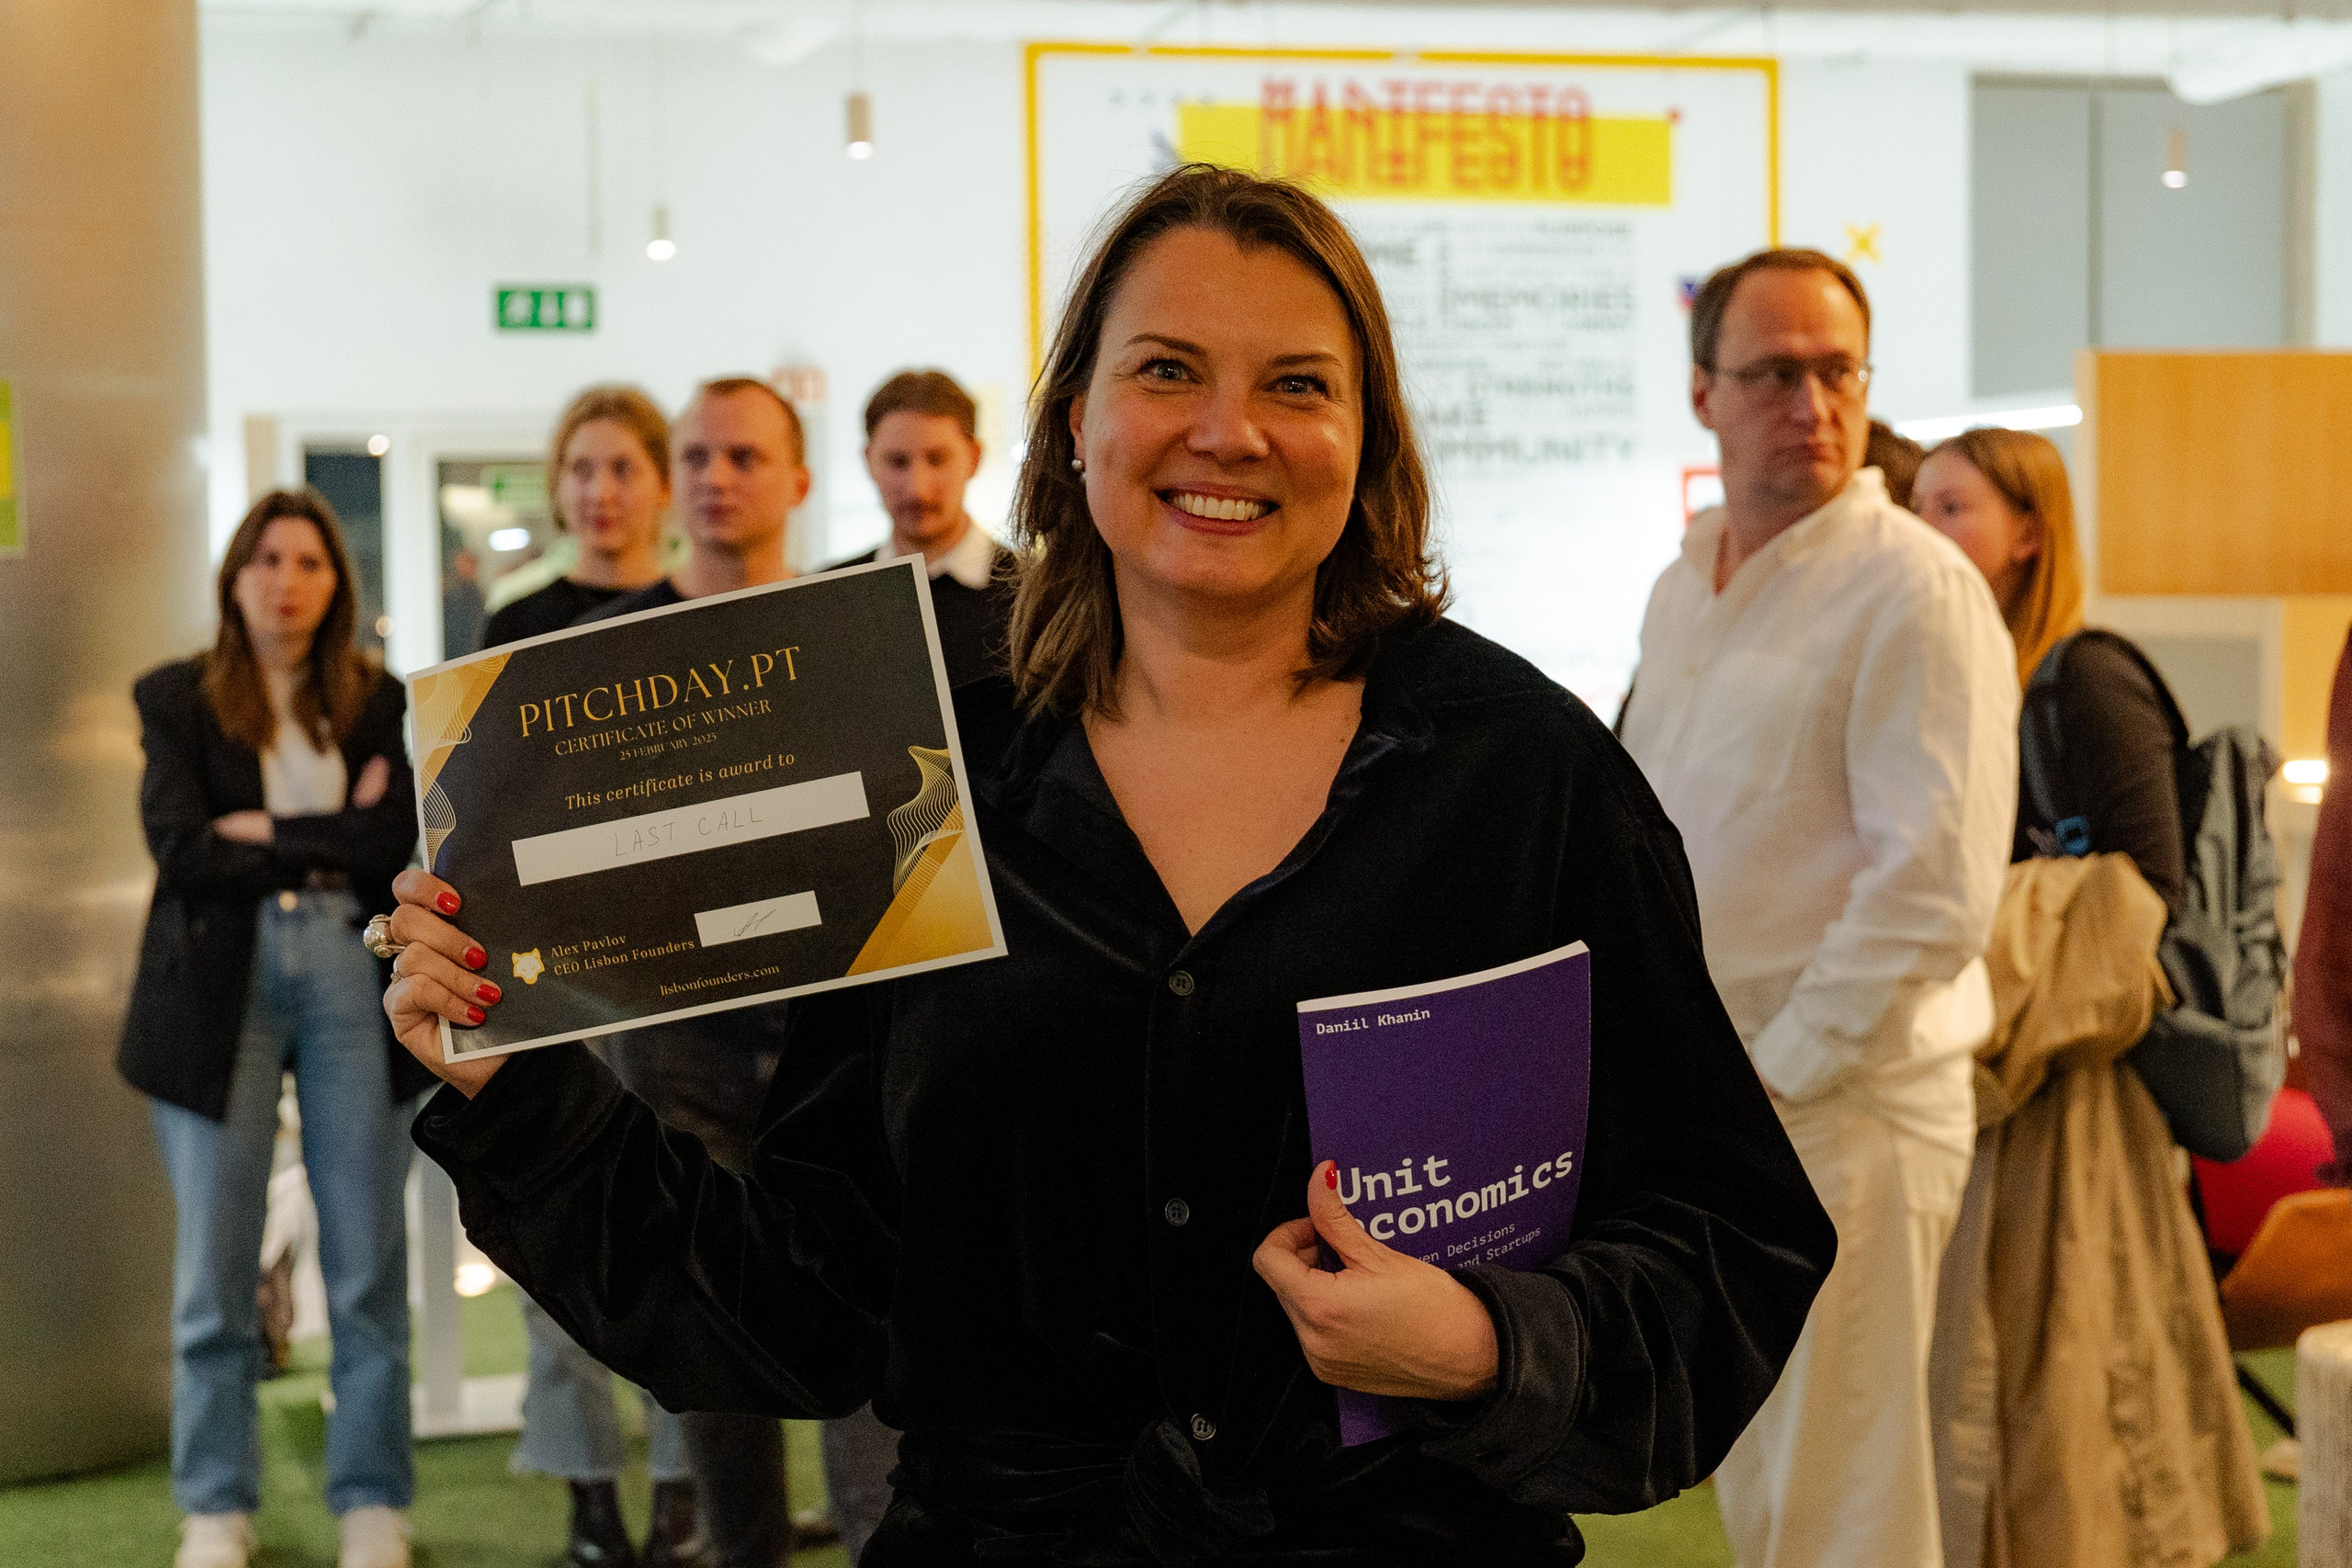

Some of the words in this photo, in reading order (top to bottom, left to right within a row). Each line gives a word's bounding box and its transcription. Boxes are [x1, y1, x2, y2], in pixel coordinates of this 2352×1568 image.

[1261, 77, 1592, 192] MANIFESTO
[518, 646, 800, 737] PITCHDAY.PT
[554, 719, 669, 756] CERTIFICATE
[673, 713, 696, 732] OF
[701, 699, 773, 727] WINNER
[619, 750, 631, 761] 25
[693, 732, 718, 746] 2025
[565, 791, 601, 810] This
[606, 773, 694, 801] certificate
[699, 767, 713, 783] is
[718, 754, 773, 779] award
[778, 752, 796, 767] to
[615, 821, 675, 856] LAST
[697, 807, 763, 835] CALL
[550, 944, 580, 959] Alex
[583, 934, 627, 952] Pavlov
[554, 961, 581, 976] CEO
[584, 953, 628, 971] Lisbon
[632, 938, 695, 961] Founders
[660, 965, 781, 997] lisbonfounders.com
[1316, 1017, 1369, 1035] Daniil
[1378, 1009, 1430, 1027] Khanin
[1336, 1155, 1452, 1205] Unit
[1355, 1150, 1574, 1240] conomics
[1447, 1223, 1515, 1258] Decisions
[1487, 1226, 1542, 1261] Startups
